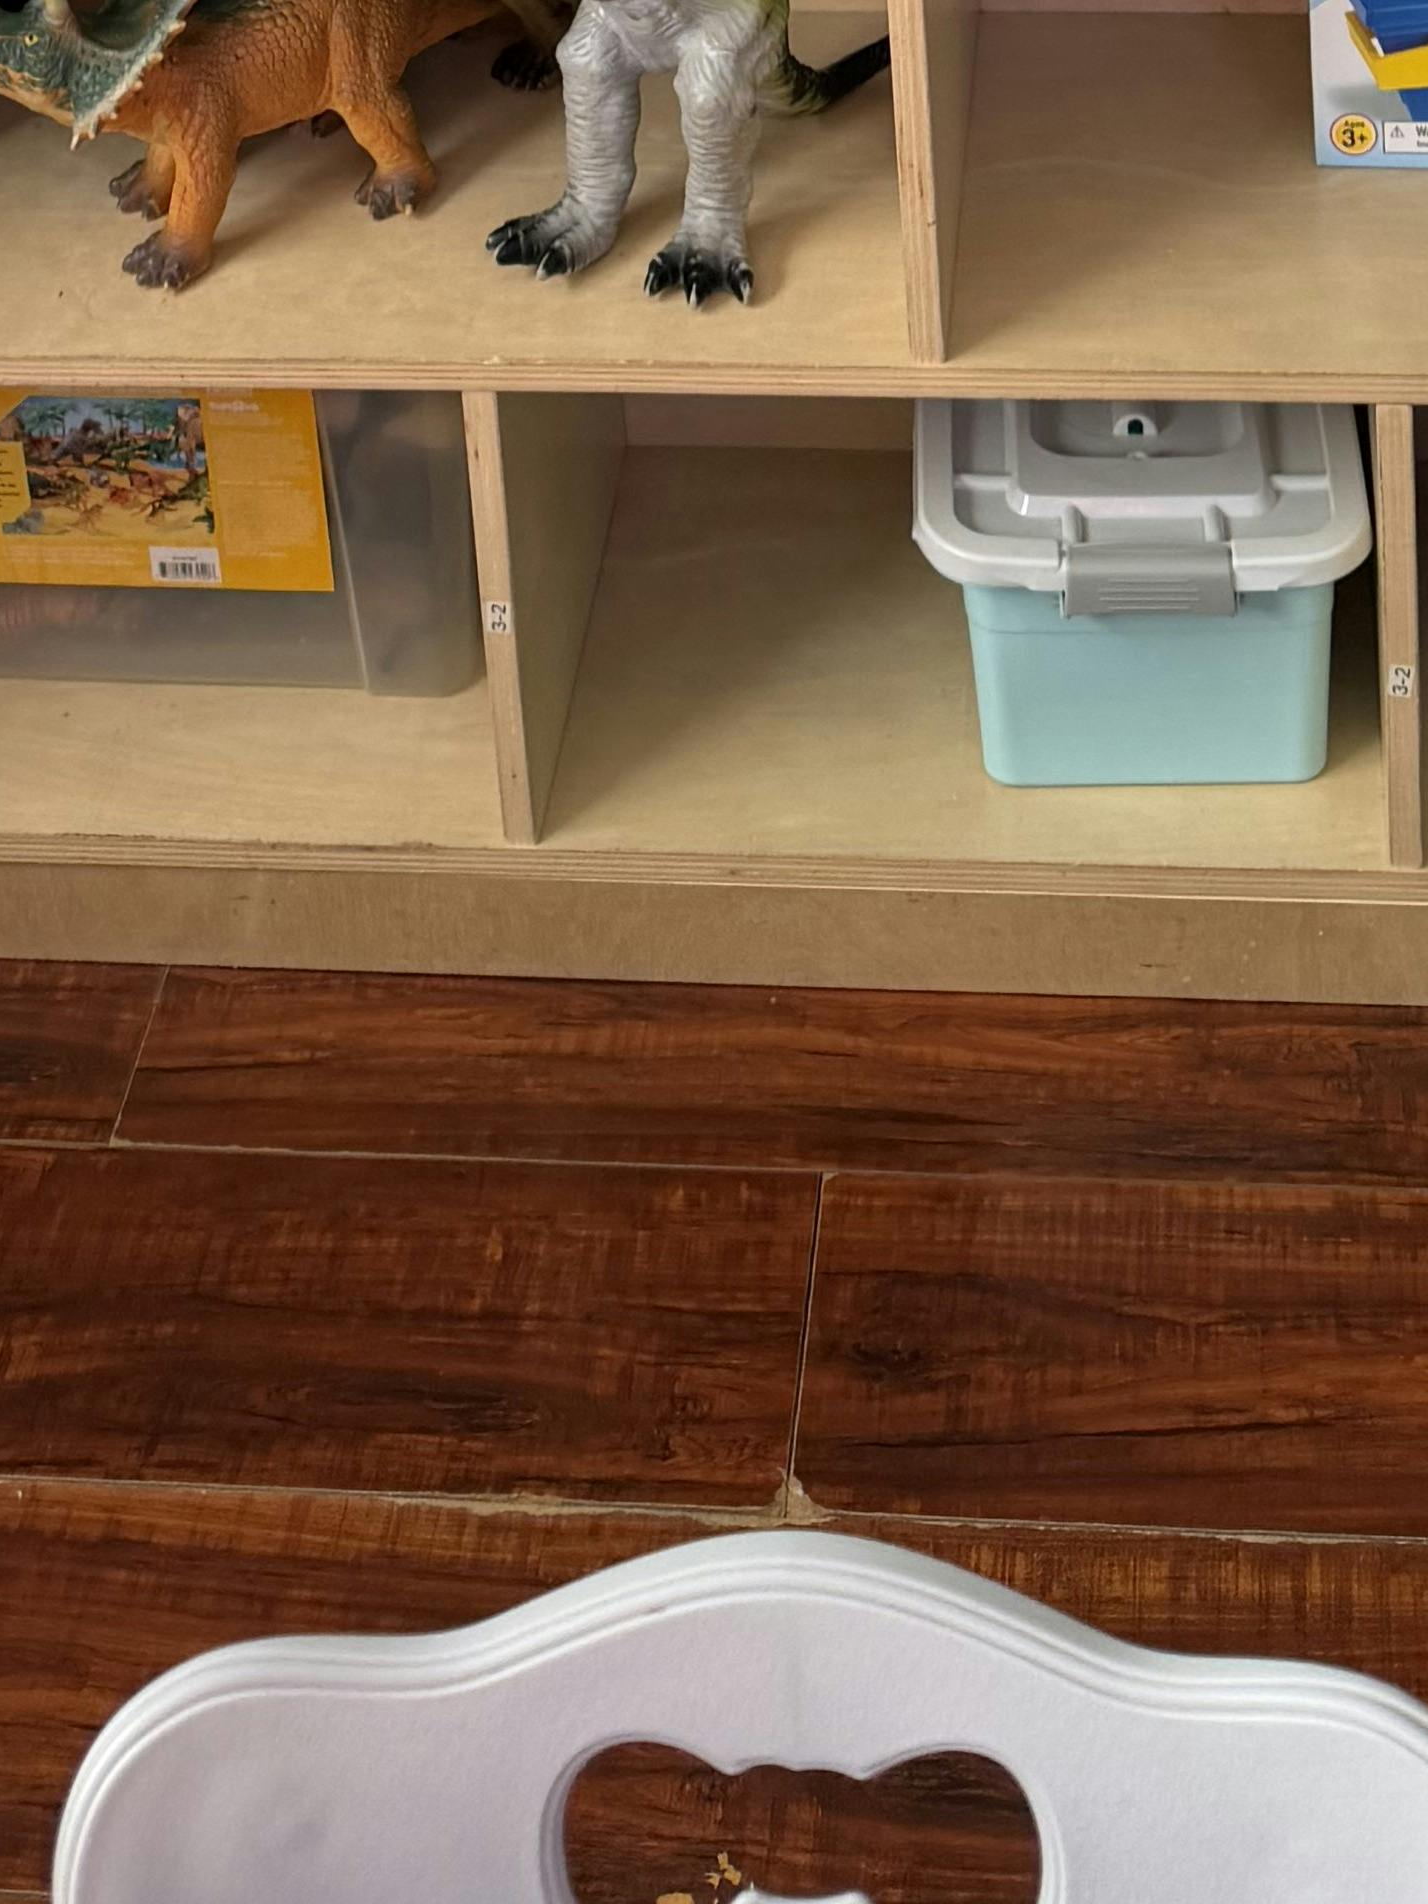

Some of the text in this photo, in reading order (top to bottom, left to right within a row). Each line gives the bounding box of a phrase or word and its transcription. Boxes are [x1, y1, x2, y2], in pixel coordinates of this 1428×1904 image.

[1342, 128, 1368, 148] 3+
[490, 602, 507, 632] 3-2
[1392, 666, 1411, 696] 3-2
